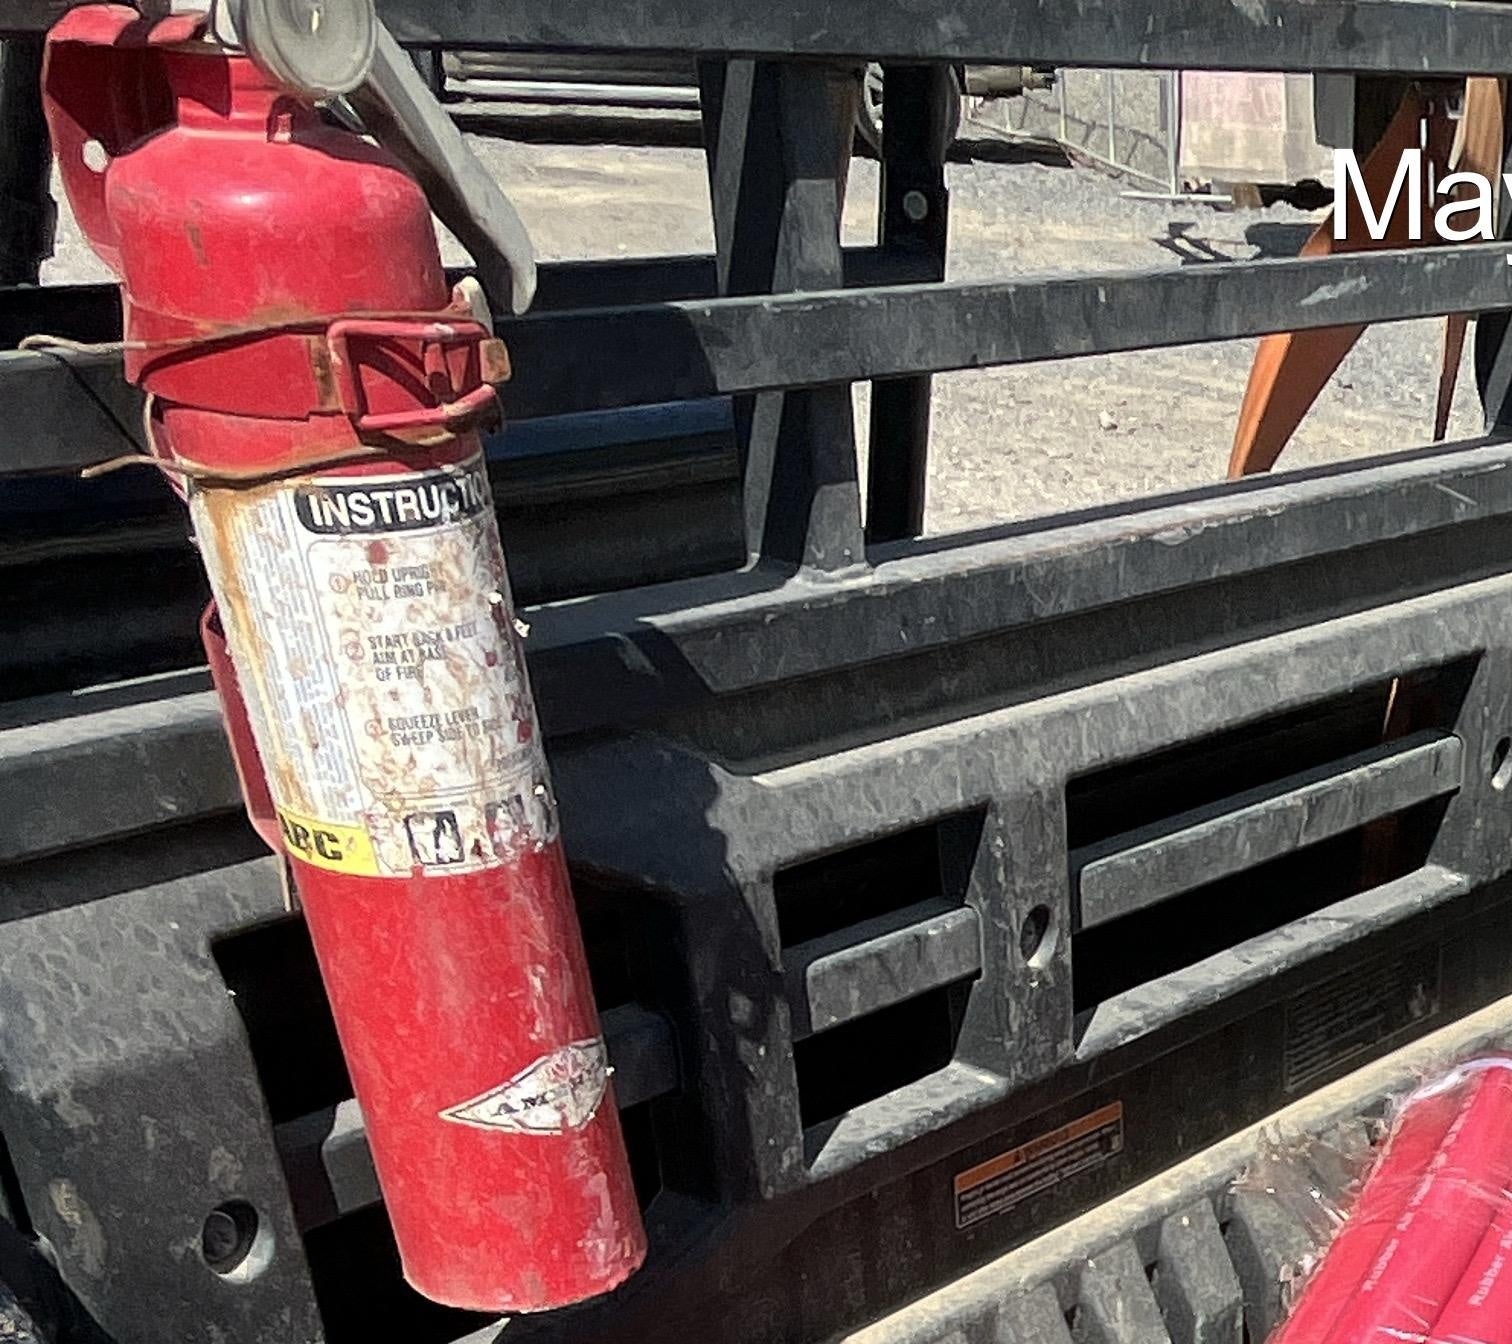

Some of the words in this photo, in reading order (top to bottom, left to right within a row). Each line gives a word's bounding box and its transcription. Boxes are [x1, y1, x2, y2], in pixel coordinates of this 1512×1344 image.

[353, 569, 388, 584] HOLD
[367, 630, 410, 650] START
[401, 648, 416, 663] AT
[390, 730, 434, 747] SWEEP
[1467, 1252, 1506, 1308] Rubber
